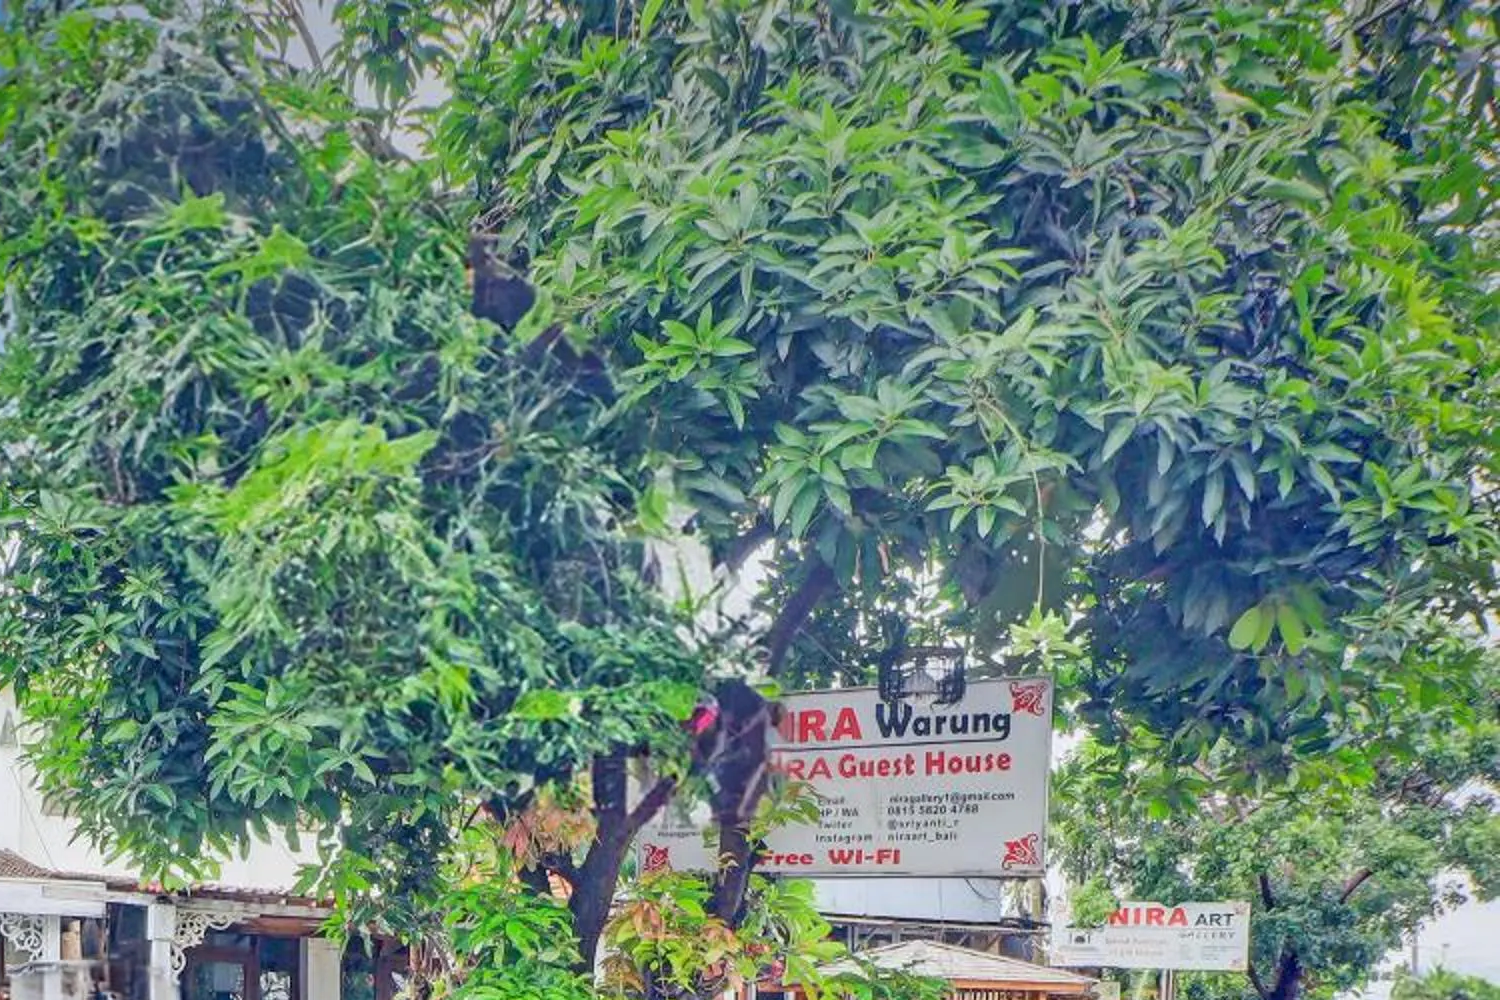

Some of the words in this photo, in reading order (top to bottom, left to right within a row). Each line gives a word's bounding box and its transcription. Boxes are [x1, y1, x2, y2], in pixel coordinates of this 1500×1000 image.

[778, 707, 862, 743] IRA
[875, 703, 1011, 739] Warung
[838, 753, 915, 778] Guest
[924, 750, 1011, 776] House
[815, 833, 873, 844] Instagram
[827, 849, 901, 865] WI-FI
[1108, 907, 1189, 928] NIRA
[1194, 913, 1235, 927] ART
